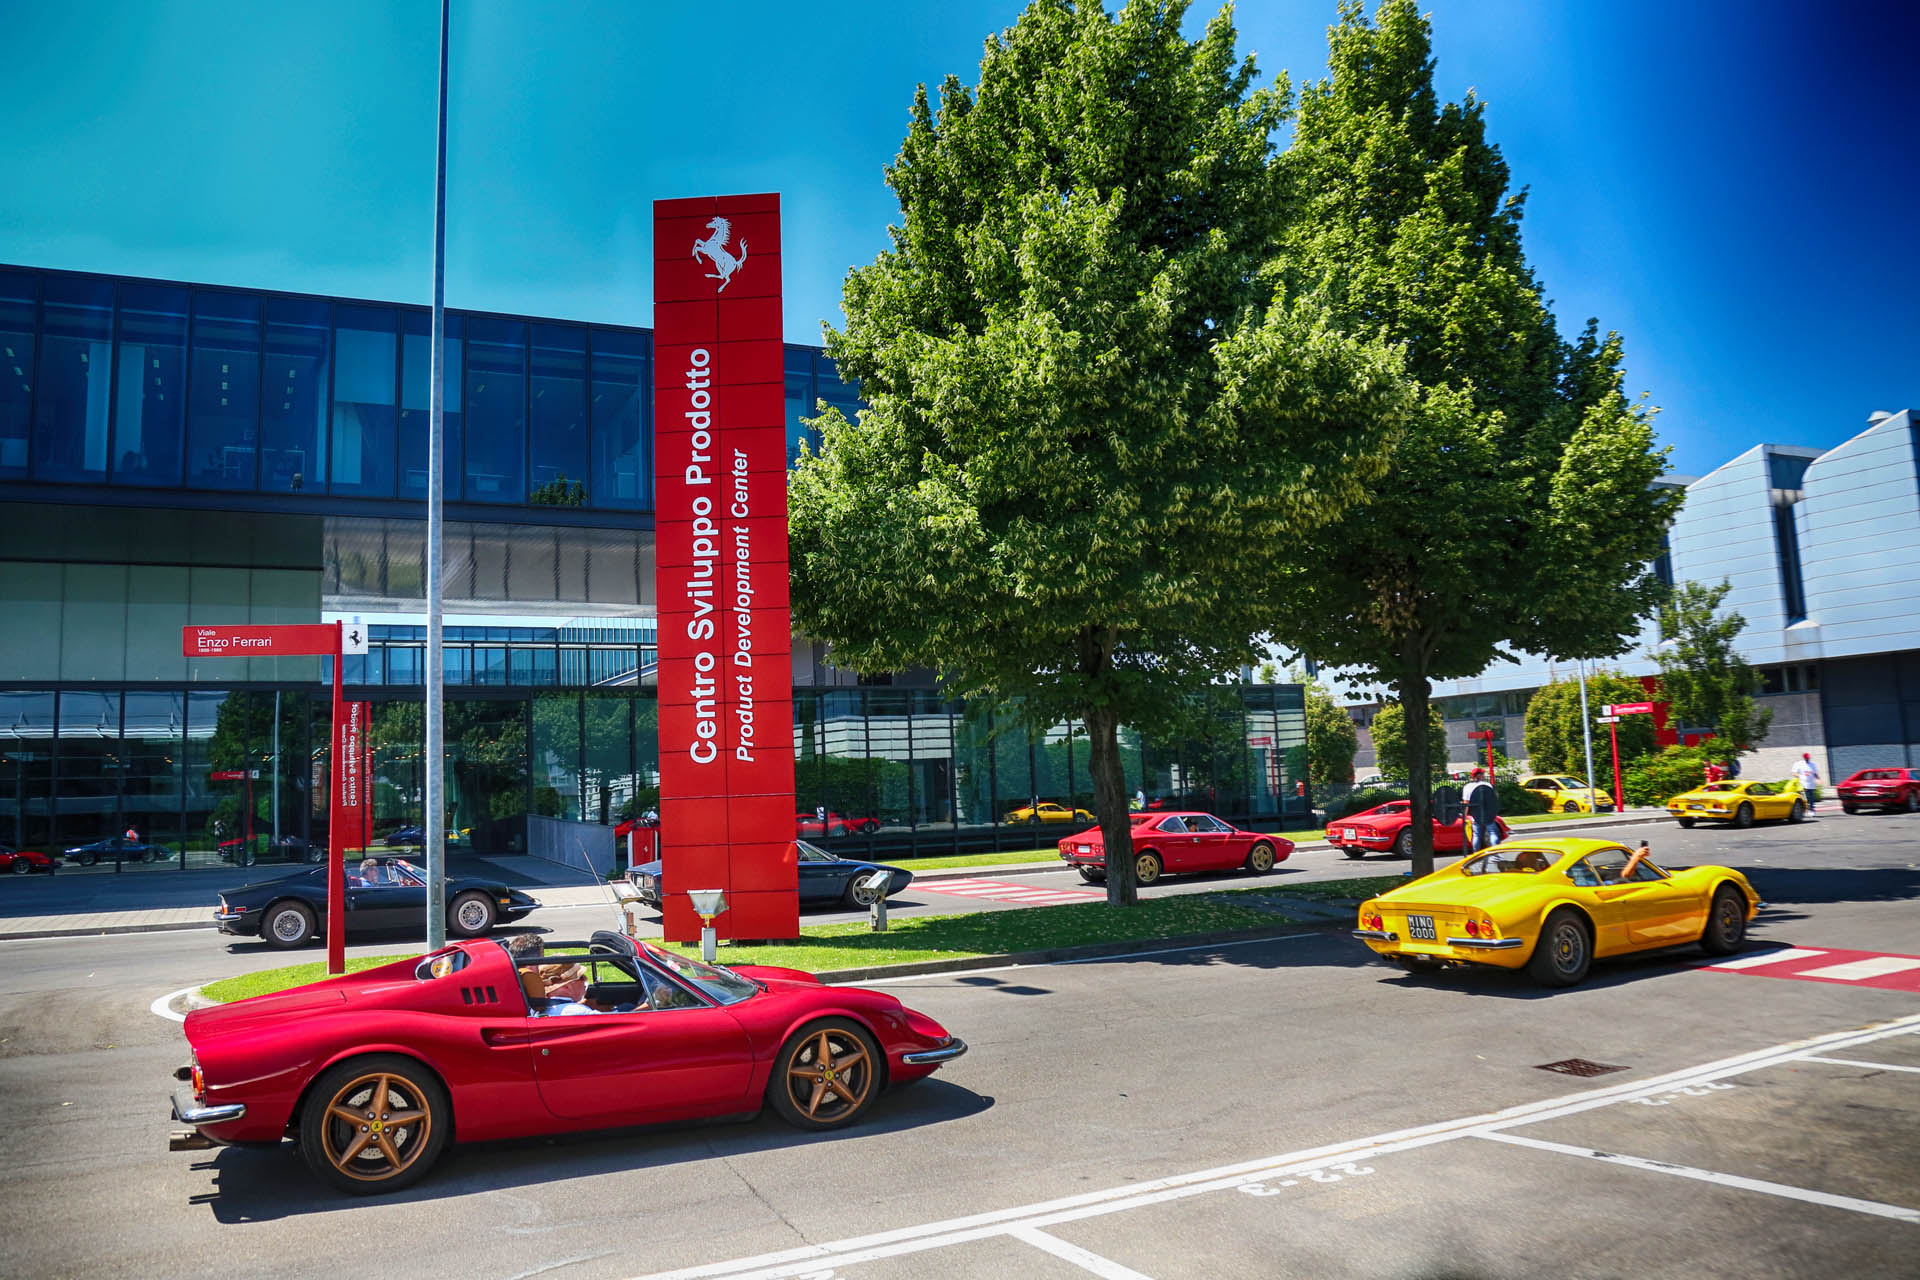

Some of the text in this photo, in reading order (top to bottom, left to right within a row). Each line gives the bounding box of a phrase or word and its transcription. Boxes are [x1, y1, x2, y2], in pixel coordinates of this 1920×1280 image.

[685, 348, 719, 764] Centro Sviluppo Prodotto
[731, 448, 754, 762] Product Development Center
[198, 636, 272, 647] Enzo Ferrari
[1411, 927, 1435, 939] 2000
